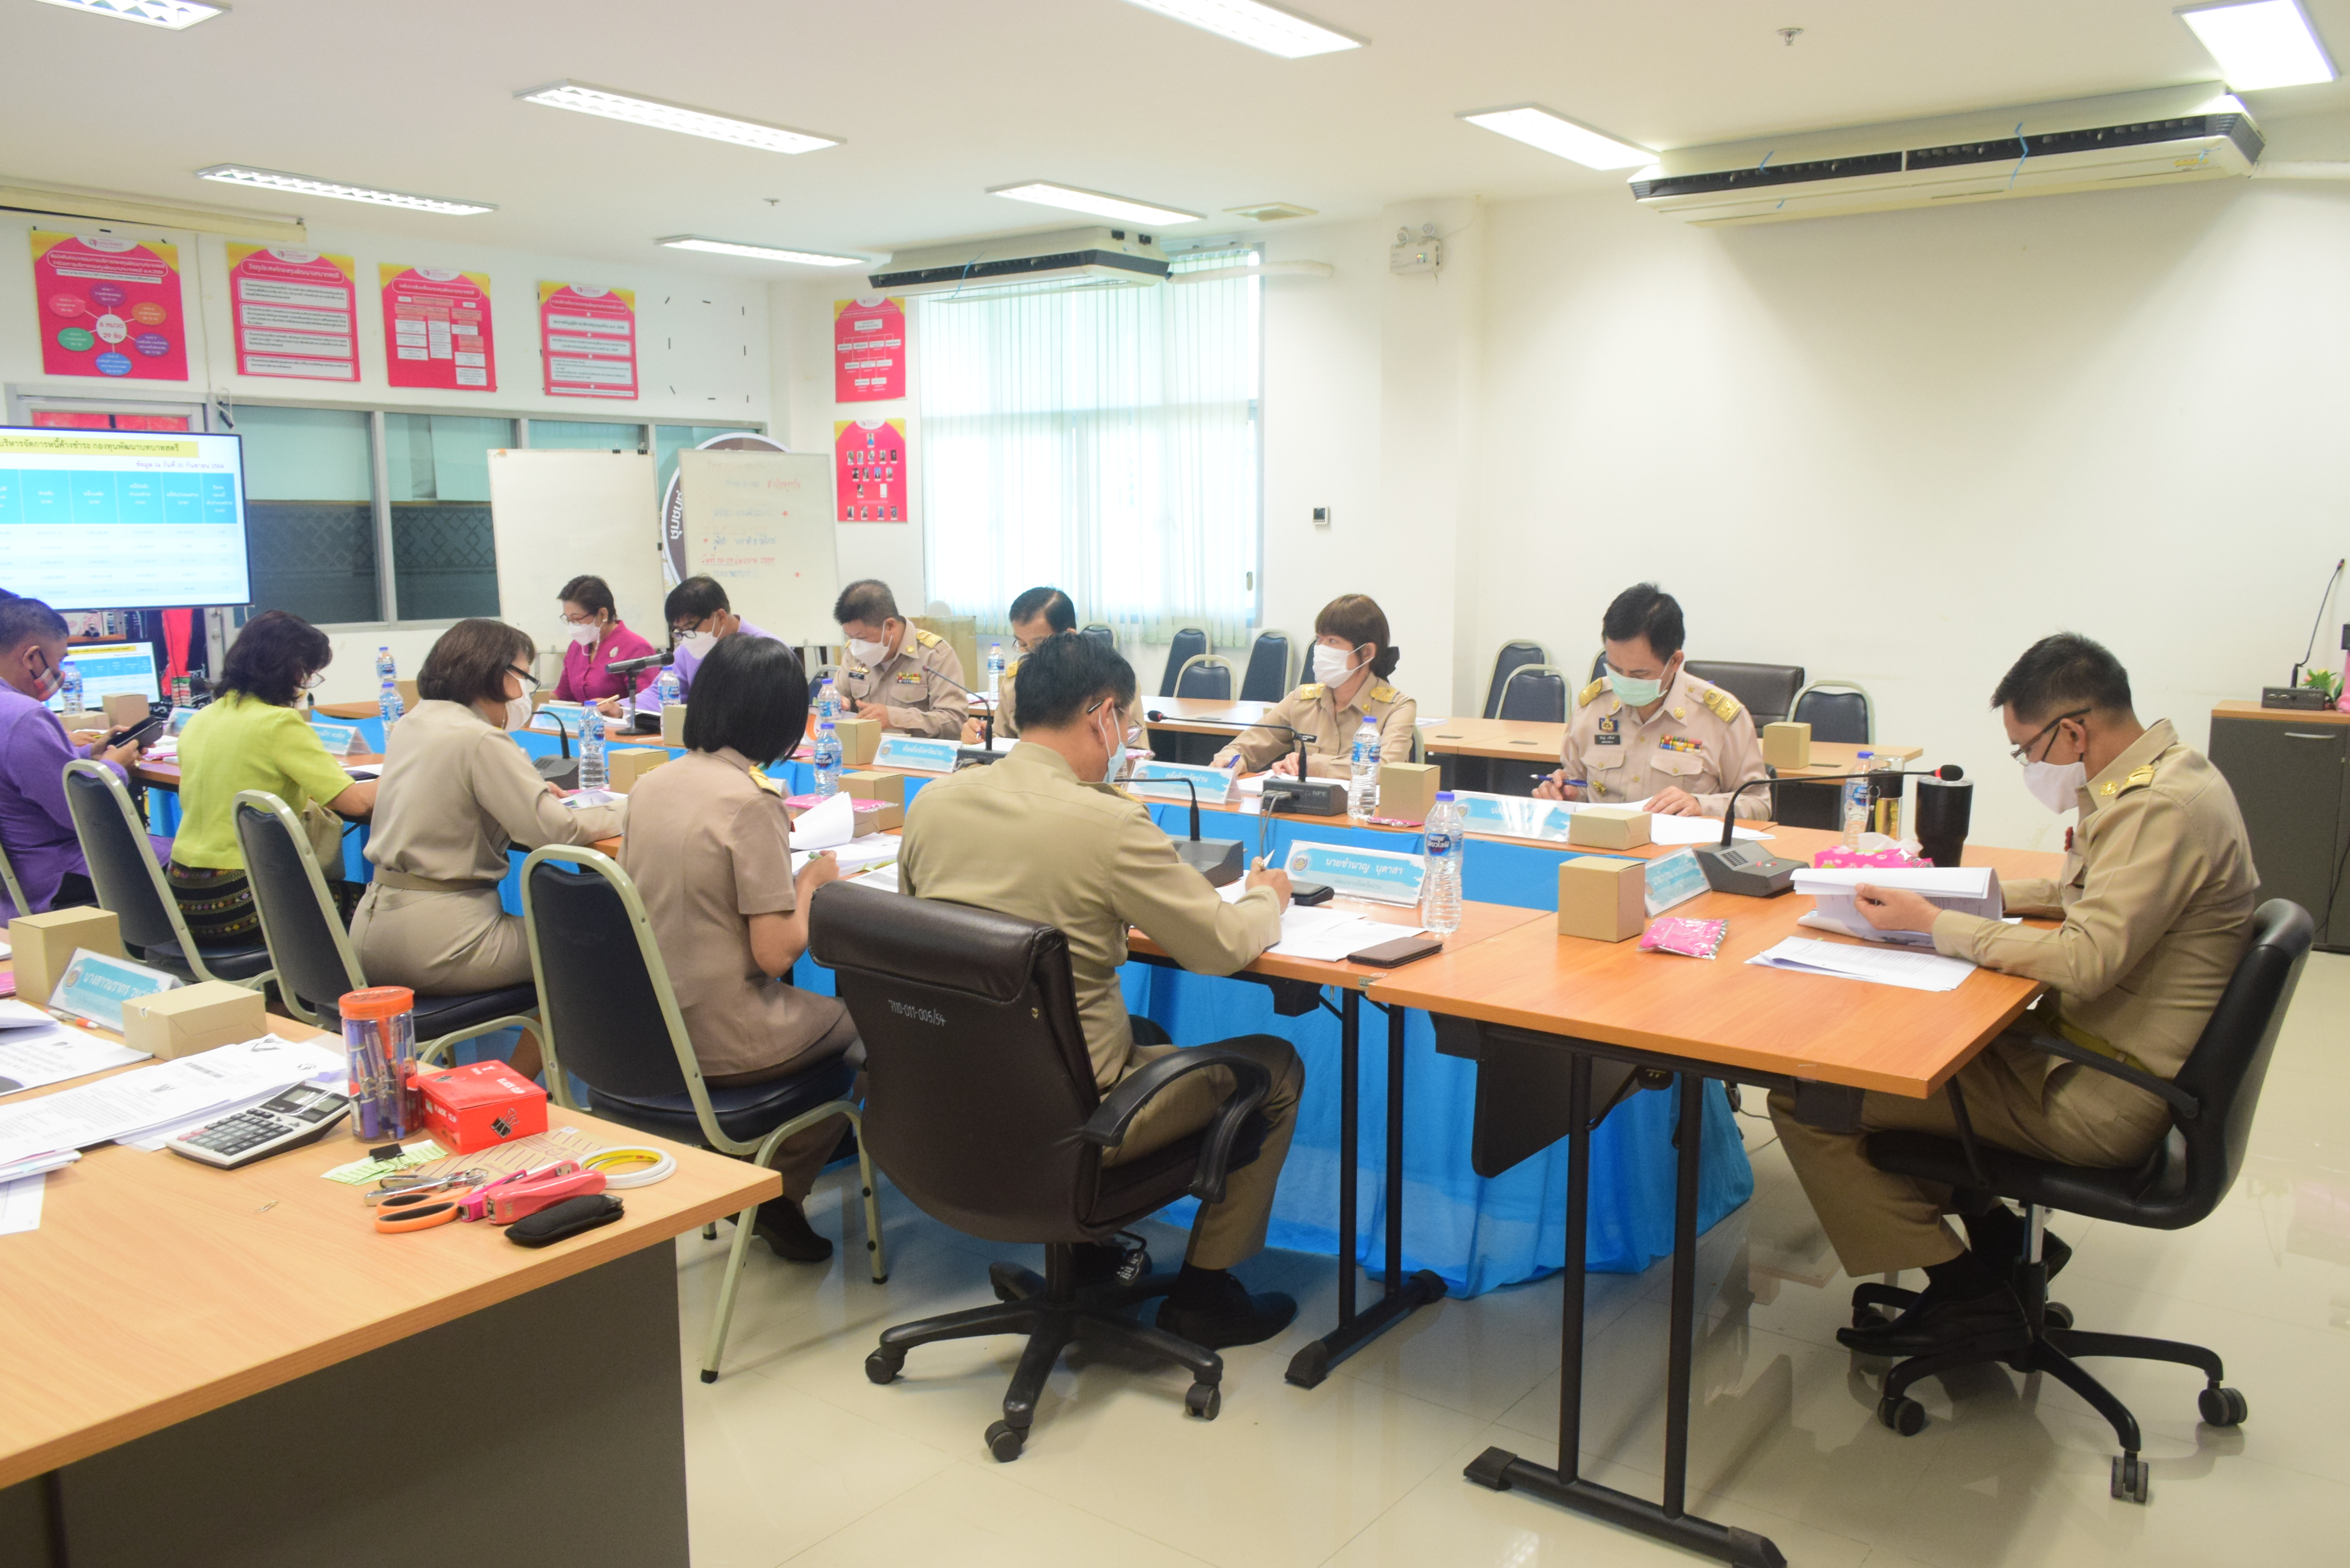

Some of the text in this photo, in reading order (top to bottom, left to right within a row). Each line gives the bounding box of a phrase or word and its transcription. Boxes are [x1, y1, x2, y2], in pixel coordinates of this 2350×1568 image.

[93, 441, 179, 453] กองทุนพัฒนาบทบาทสตรี
[1326, 857, 1403, 875] นายชำนาญ บุดาสา
[497, 1078, 516, 1089] BLACK
[448, 1113, 457, 1123] CLIP
